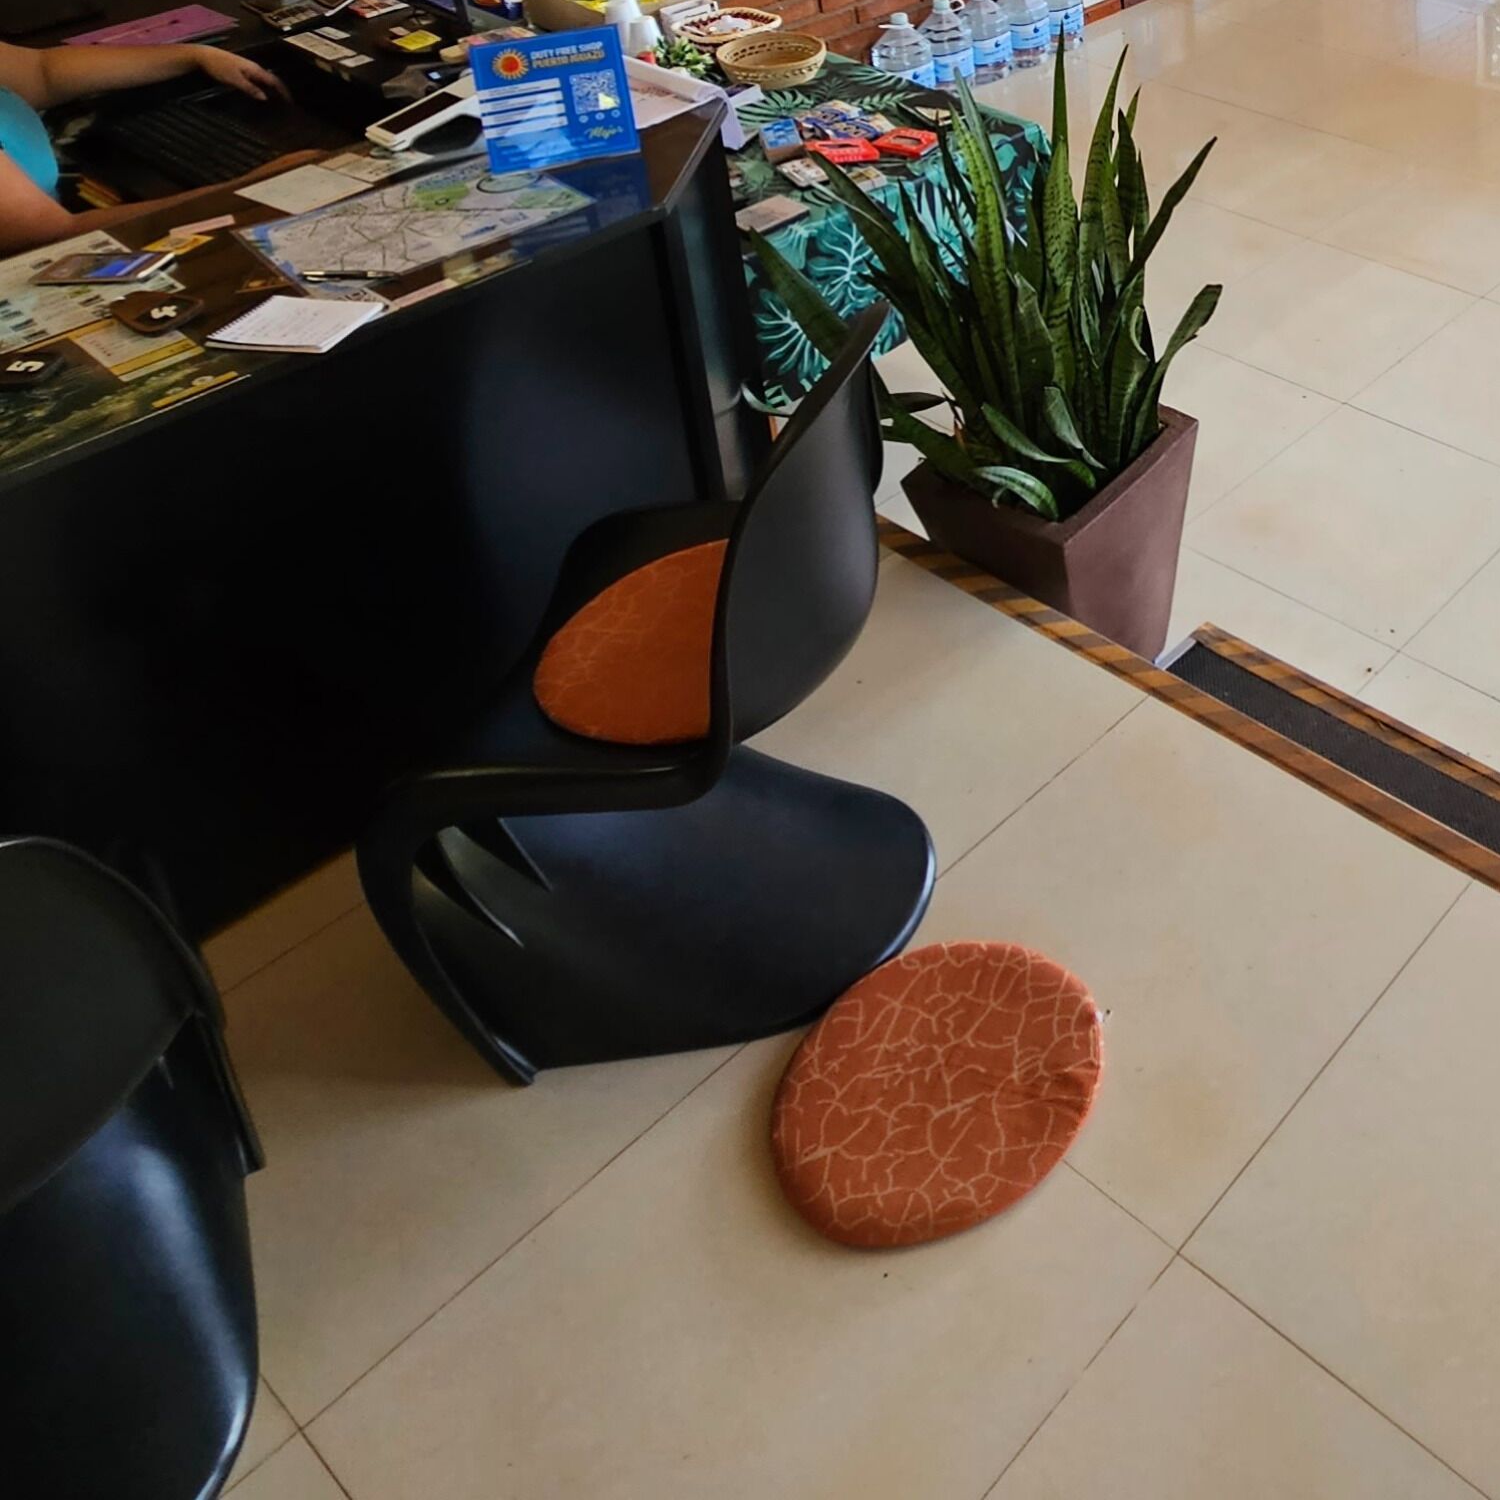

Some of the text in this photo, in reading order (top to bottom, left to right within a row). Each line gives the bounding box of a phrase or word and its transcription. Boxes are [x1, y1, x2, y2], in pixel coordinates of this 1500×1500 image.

[530, 41, 603, 60] DUTY FREE SHOP
[532, 57, 569, 68] PUERTO
